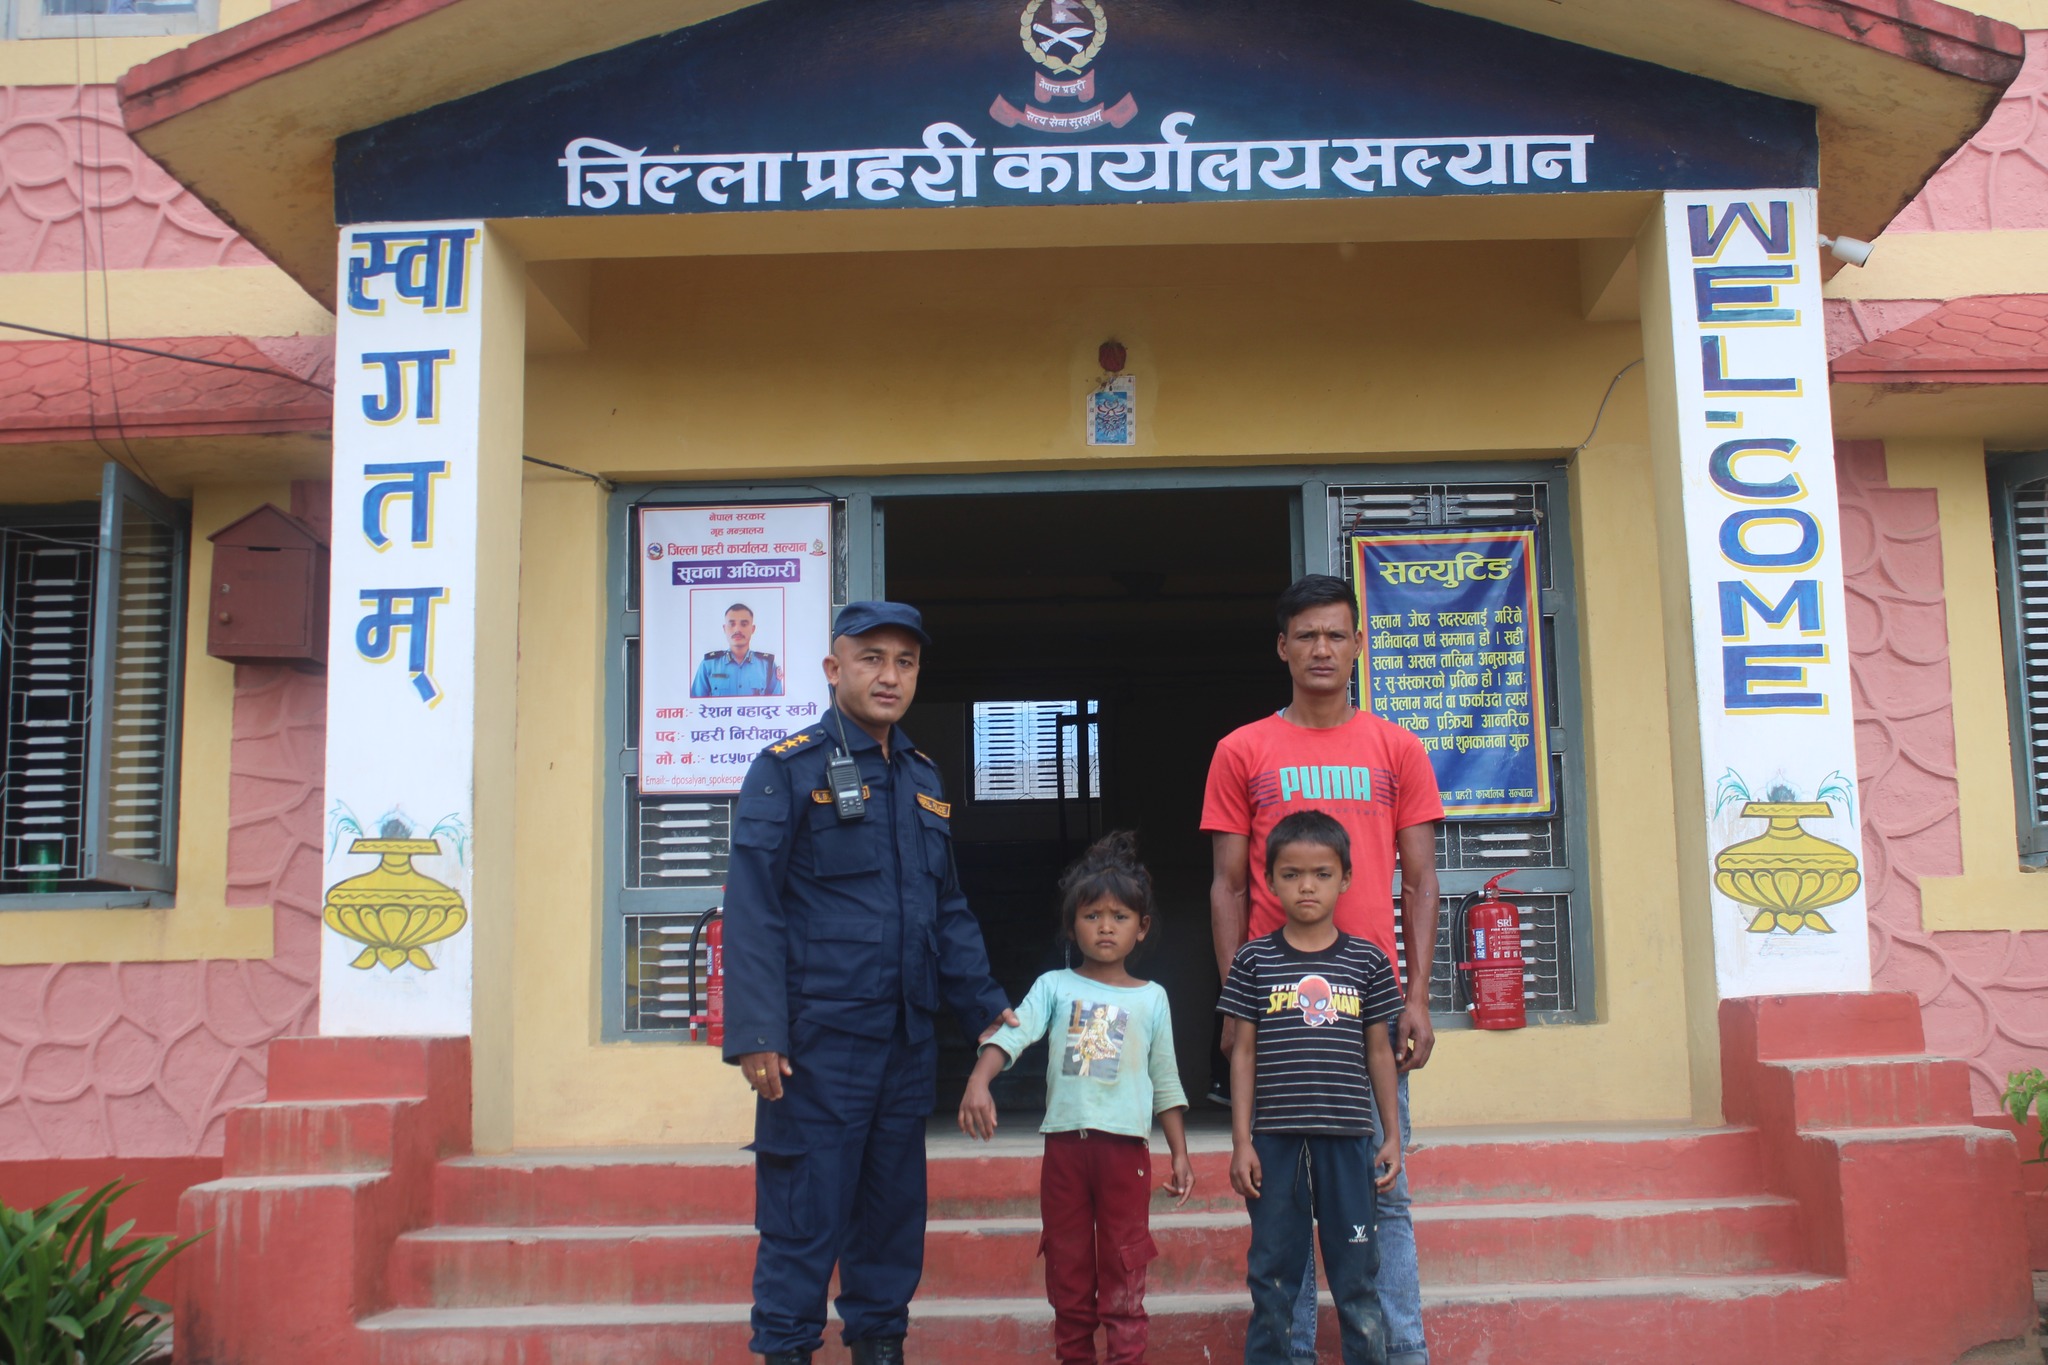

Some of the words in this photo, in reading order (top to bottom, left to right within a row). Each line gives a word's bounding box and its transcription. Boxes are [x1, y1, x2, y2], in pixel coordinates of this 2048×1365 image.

[1039, 78, 1060, 94] नेपाल
[1061, 80, 1087, 94] प्रहरी
[1026, 111, 1047, 126] सत्य
[1049, 116, 1067, 127] सेवा
[558, 137, 793, 208] जिल्ला
[798, 122, 985, 201] प्रहरी
[993, 111, 1329, 193] कार्यालय
[1331, 135, 1594, 192] सल्यान
[709, 512, 733, 522] नेपाल
[736, 512, 766, 521] सरकार
[710, 528, 724, 537] गृह
[727, 527, 764, 536] मन्त्रालय
[668, 542, 698, 556] जिल्ला
[701, 542, 724, 556] प्रहरी
[773, 542, 807, 554] सल्यान
[677, 566, 722, 584] सूचना
[727, 561, 796, 578] अधिकारी
[1379, 552, 1513, 588] सल्युटिङ
[1370, 614, 1402, 630] सलाम
[1408, 609, 1431, 628] जेष्ठ
[1438, 608, 1488, 628] सदस्यलाई
[1494, 606, 1522, 624] गरिने
[1372, 631, 1419, 650] अभिवादन
[1423, 630, 1436, 648] एवं
[1440, 632, 1475, 648] सम्मान
[1478, 628, 1490, 646] हो
[1504, 626, 1524, 645] सही
[1372, 656, 1403, 671] सलाम
[1408, 654, 1436, 670] असल
[1440, 649, 1474, 668] तालिम
[1478, 651, 1525, 670] अनुसासन
[1373, 676, 1381, 692] र
[1450, 670, 1478, 690] प्रतिक
[1482, 668, 1492, 688] हो
[699, 704, 732, 718] रेशम
[737, 705, 781, 720] बहादुर
[786, 702, 818, 716] खत्री
[1374, 695, 1388, 712] एवं
[1390, 696, 1421, 712] सलाम
[1424, 692, 1443, 710] गर्दा
[1446, 696, 1456, 708] वा
[1505, 691, 1528, 707] त्यस
[1436, 710, 1474, 732] प्रक्रिया
[1481, 708, 1530, 728] आन्तरिक
[691, 726, 726, 743] प्रहरी
[730, 726, 788, 742] निरीक्षक
[1441, 734, 1454, 750] एवं
[1456, 734, 1506, 754] शुभकामना
[1509, 734, 1530, 752] युक्त
[710, 752, 760, 765] ९८५७८
[1279, 766, 1372, 802] PUMA
[1332, 986, 1359, 996] ENSE
